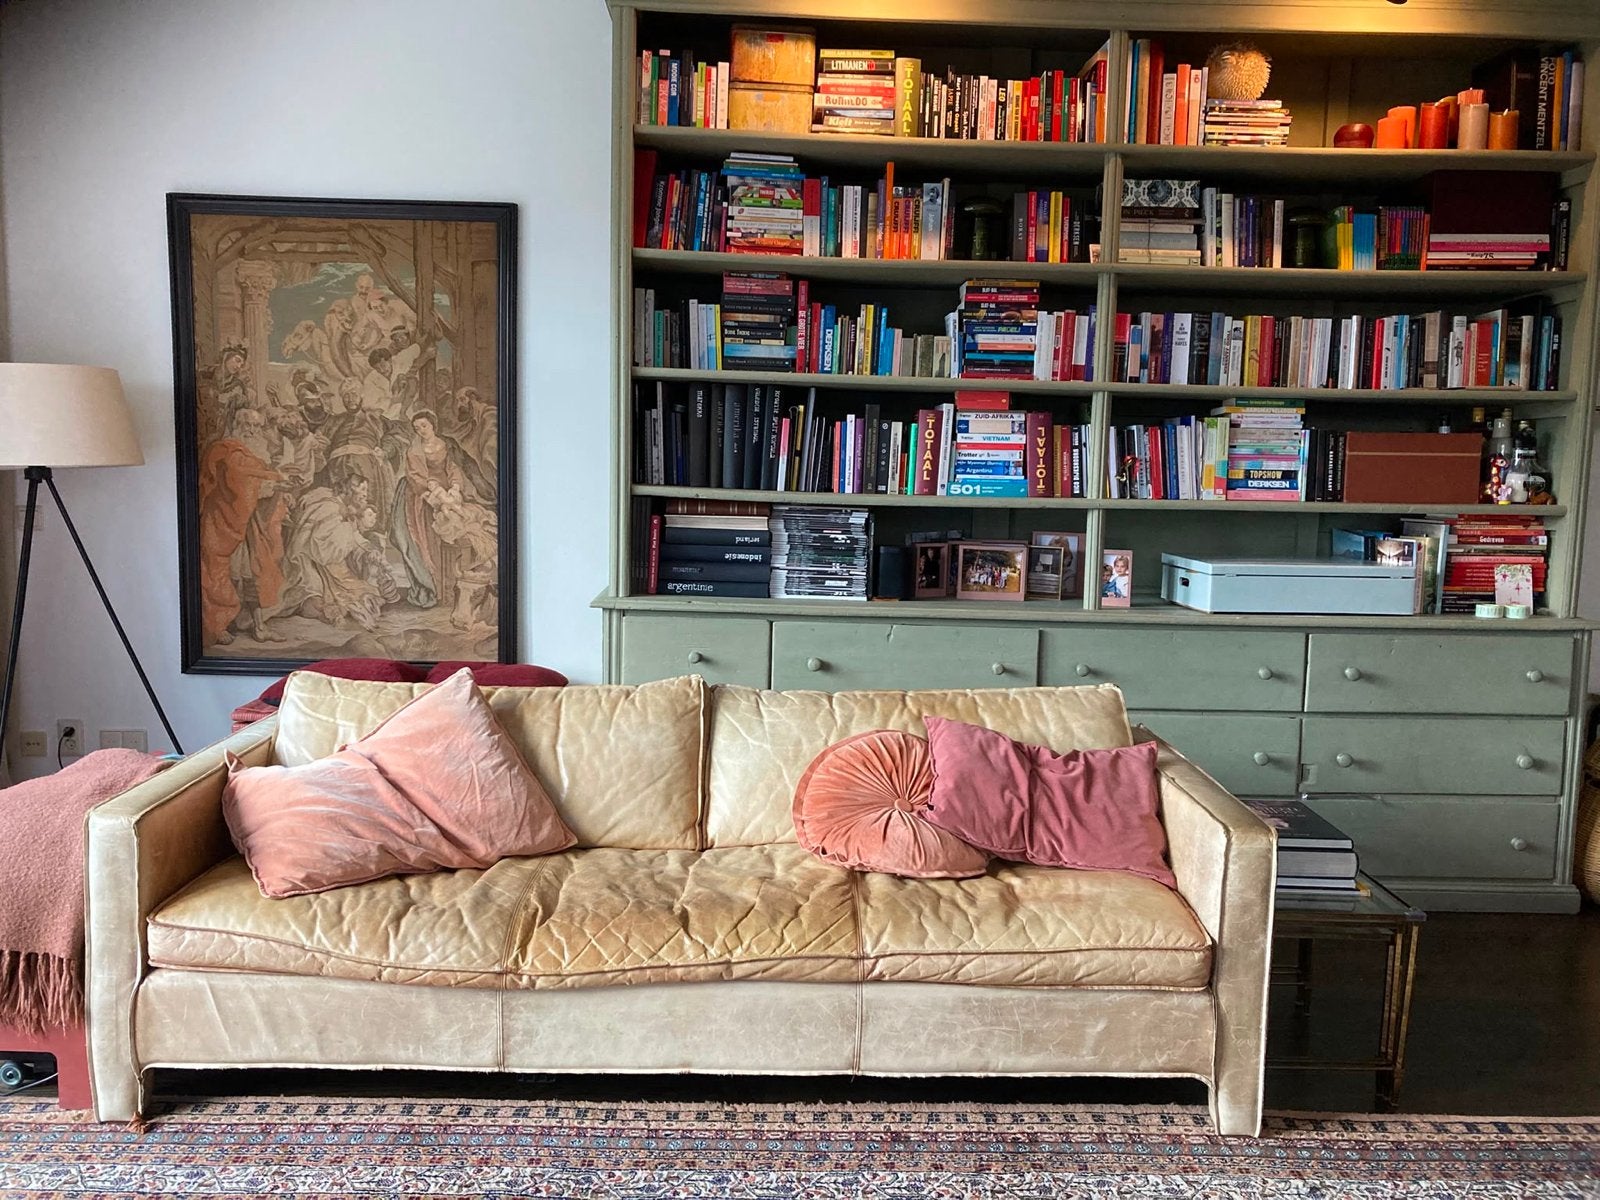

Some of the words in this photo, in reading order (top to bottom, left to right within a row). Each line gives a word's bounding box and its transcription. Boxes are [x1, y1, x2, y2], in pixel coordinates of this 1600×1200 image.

[1539, 57, 1549, 101] VINCENT
[902, 67, 914, 133] TOTAAL
[998, 87, 1007, 102] LEO
[1535, 102, 1547, 149] MENTZEL
[799, 310, 806, 318] DE
[798, 319, 806, 336] GROTE
[797, 337, 805, 350] VIER
[824, 329, 834, 371] DERKSEN
[922, 418, 936, 481] TOTAAL
[1036, 427, 1047, 489] TOTAAL
[966, 467, 993, 475] Argentina
[1250, 471, 1283, 479] TOPSHOW
[950, 484, 981, 495] 501
[1248, 480, 1290, 489] DERKSEN
